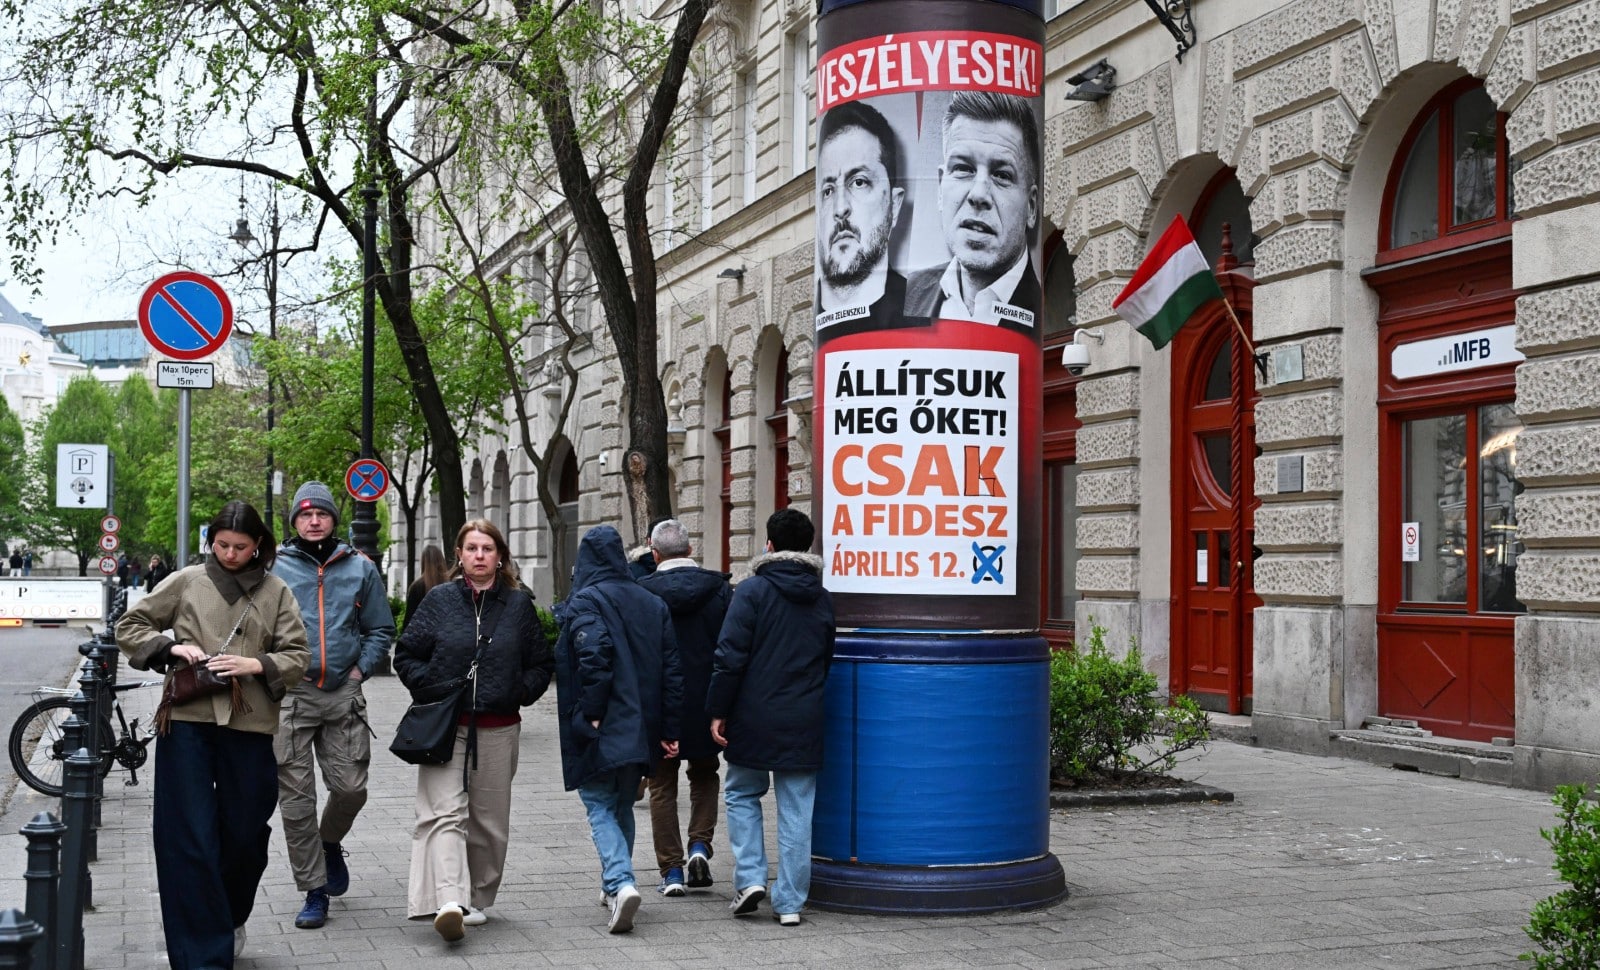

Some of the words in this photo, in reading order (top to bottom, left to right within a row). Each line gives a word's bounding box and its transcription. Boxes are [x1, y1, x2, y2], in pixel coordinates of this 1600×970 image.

[818, 34, 1036, 110] VESZÉLYESEK!
[994, 305, 1018, 318] MAGYAR
[1019, 310, 1033, 322] PÉTER
[1454, 338, 1490, 363] MFB
[162, 365, 178, 374] Max
[181, 366, 209, 376] 10perc
[177, 377, 194, 385] 15m
[835, 360, 1007, 399] ÁLLÍTSUK
[835, 407, 897, 435] MEG
[910, 399, 1006, 436] ŐKET!
[77, 457, 88, 471] P
[832, 444, 1007, 497] CSAK
[107, 520, 114, 529] 5
[832, 504, 854, 536] A
[863, 504, 1008, 537] FIDESZ
[831, 544, 919, 577] ÁPRILIS
[928, 551, 966, 578] 12.
[18, 586, 28, 598] P
